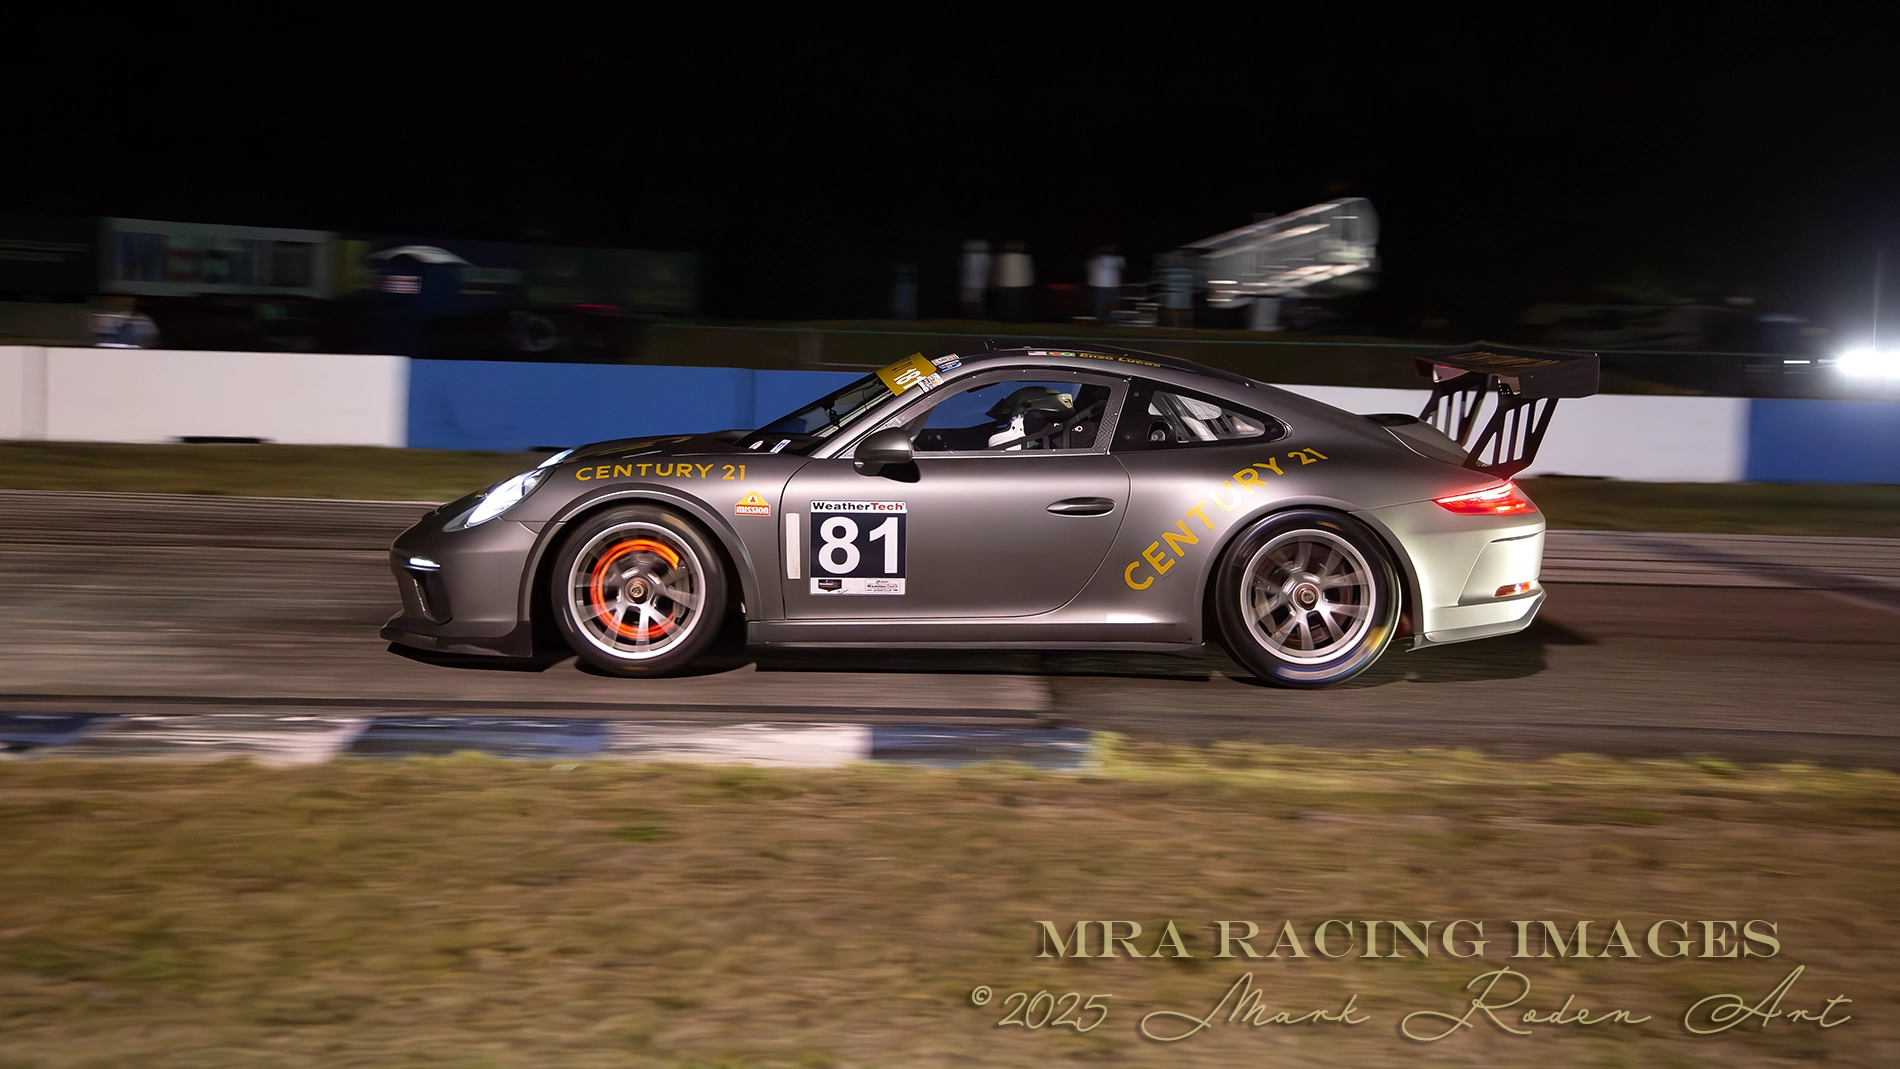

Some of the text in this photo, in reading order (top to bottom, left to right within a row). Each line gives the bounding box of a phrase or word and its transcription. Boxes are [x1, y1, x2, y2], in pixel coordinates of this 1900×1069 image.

[1079, 353, 1115, 361] Enzo
[576, 463, 746, 481] CENTURY 21
[812, 502, 905, 511] WeatherTech
[1123, 447, 1329, 591] CENTURY 21
